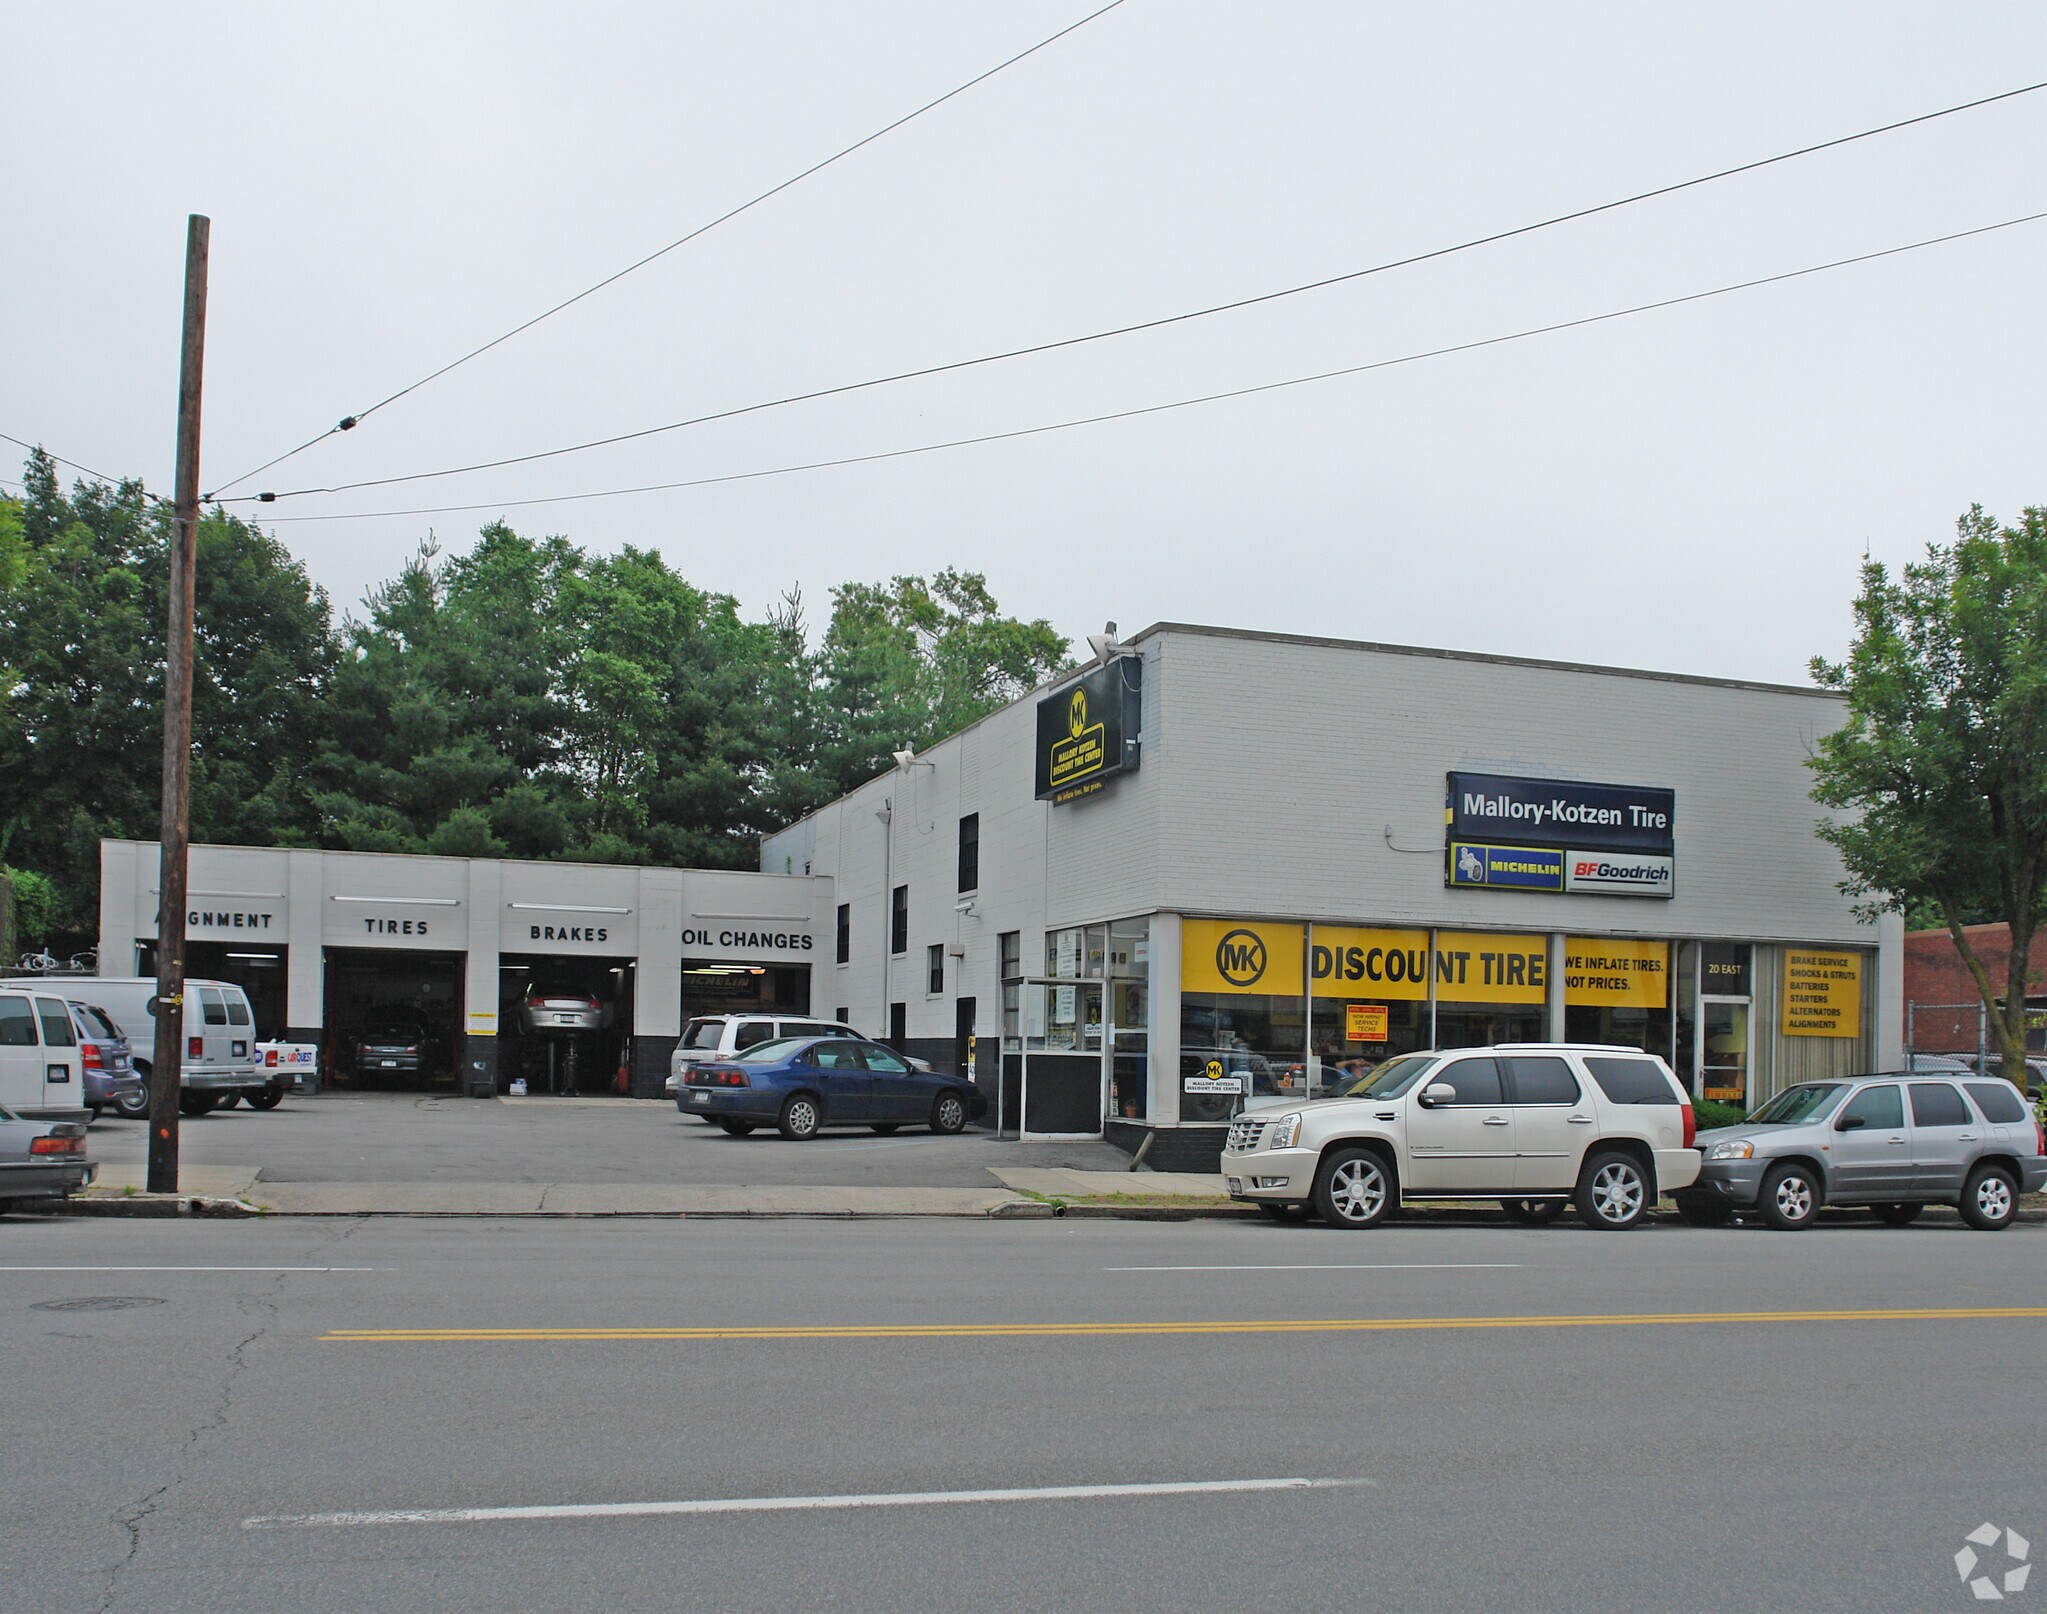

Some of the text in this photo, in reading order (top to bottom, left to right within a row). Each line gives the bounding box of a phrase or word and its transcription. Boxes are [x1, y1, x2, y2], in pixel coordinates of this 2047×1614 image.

[1071, 699, 1084, 729] MK
[1084, 748, 1101, 763] CENTER
[1463, 792, 1667, 829] Mallory-Kotzen Tire
[1490, 861, 1560, 875] MICHELIN
[1574, 862, 1669, 880] BFGoodrich
[154, 911, 272, 928] GNMENT
[365, 918, 428, 935] TIRES
[530, 925, 608, 942] BRAKES
[682, 929, 813, 950] OIL CHANGES
[1223, 944, 1260, 972] MK
[1565, 956, 1664, 972] WE INFLATE TIRES.
[1791, 956, 1849, 967] BRAKE SERVICE
[1312, 945, 1544, 987] DISCOUNT TIRE
[1708, 963, 1741, 975] 20 EAST
[1790, 969, 1856, 980] SHOCKS & STRUTS
[1565, 976, 1631, 991] NOT PRICES.
[1790, 982, 1829, 991] BATTERIES
[1790, 994, 1828, 1003] STARTERS
[1789, 1007, 1841, 1016] ALTERNATORS
[1789, 1020, 1837, 1029] ALIGNMENTS
[1207, 1066, 1221, 1075] MK
